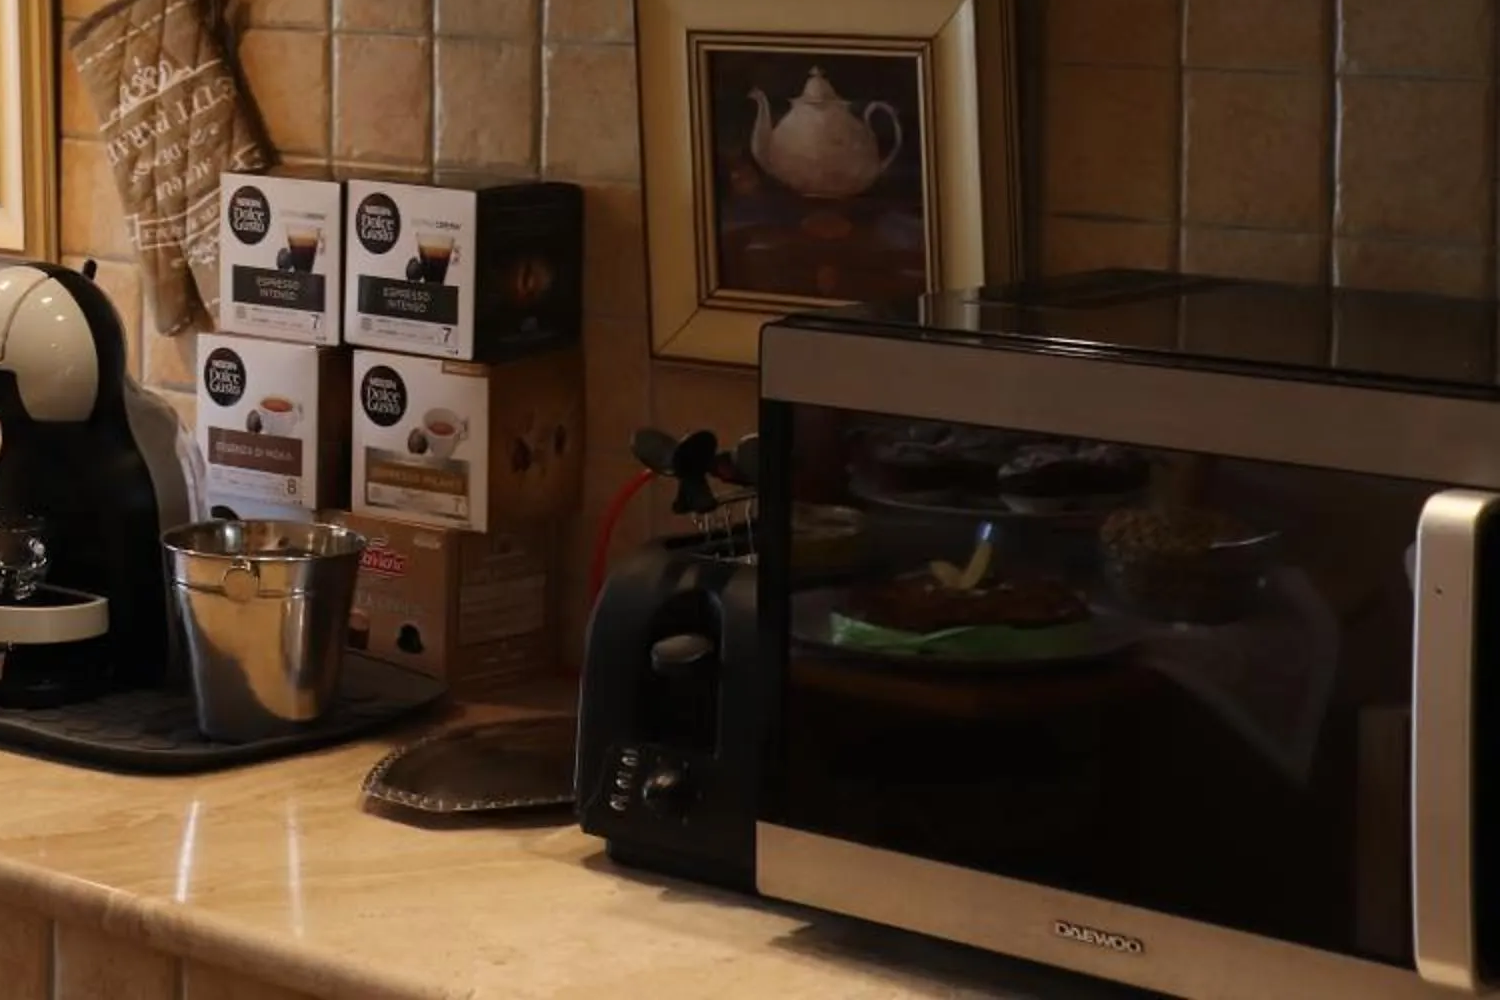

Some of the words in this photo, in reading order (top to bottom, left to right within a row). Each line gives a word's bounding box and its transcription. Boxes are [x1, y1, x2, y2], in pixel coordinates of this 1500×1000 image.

[311, 314, 321, 330] 7
[443, 327, 453, 343] 7
[1054, 919, 1145, 953] DAEWOO
